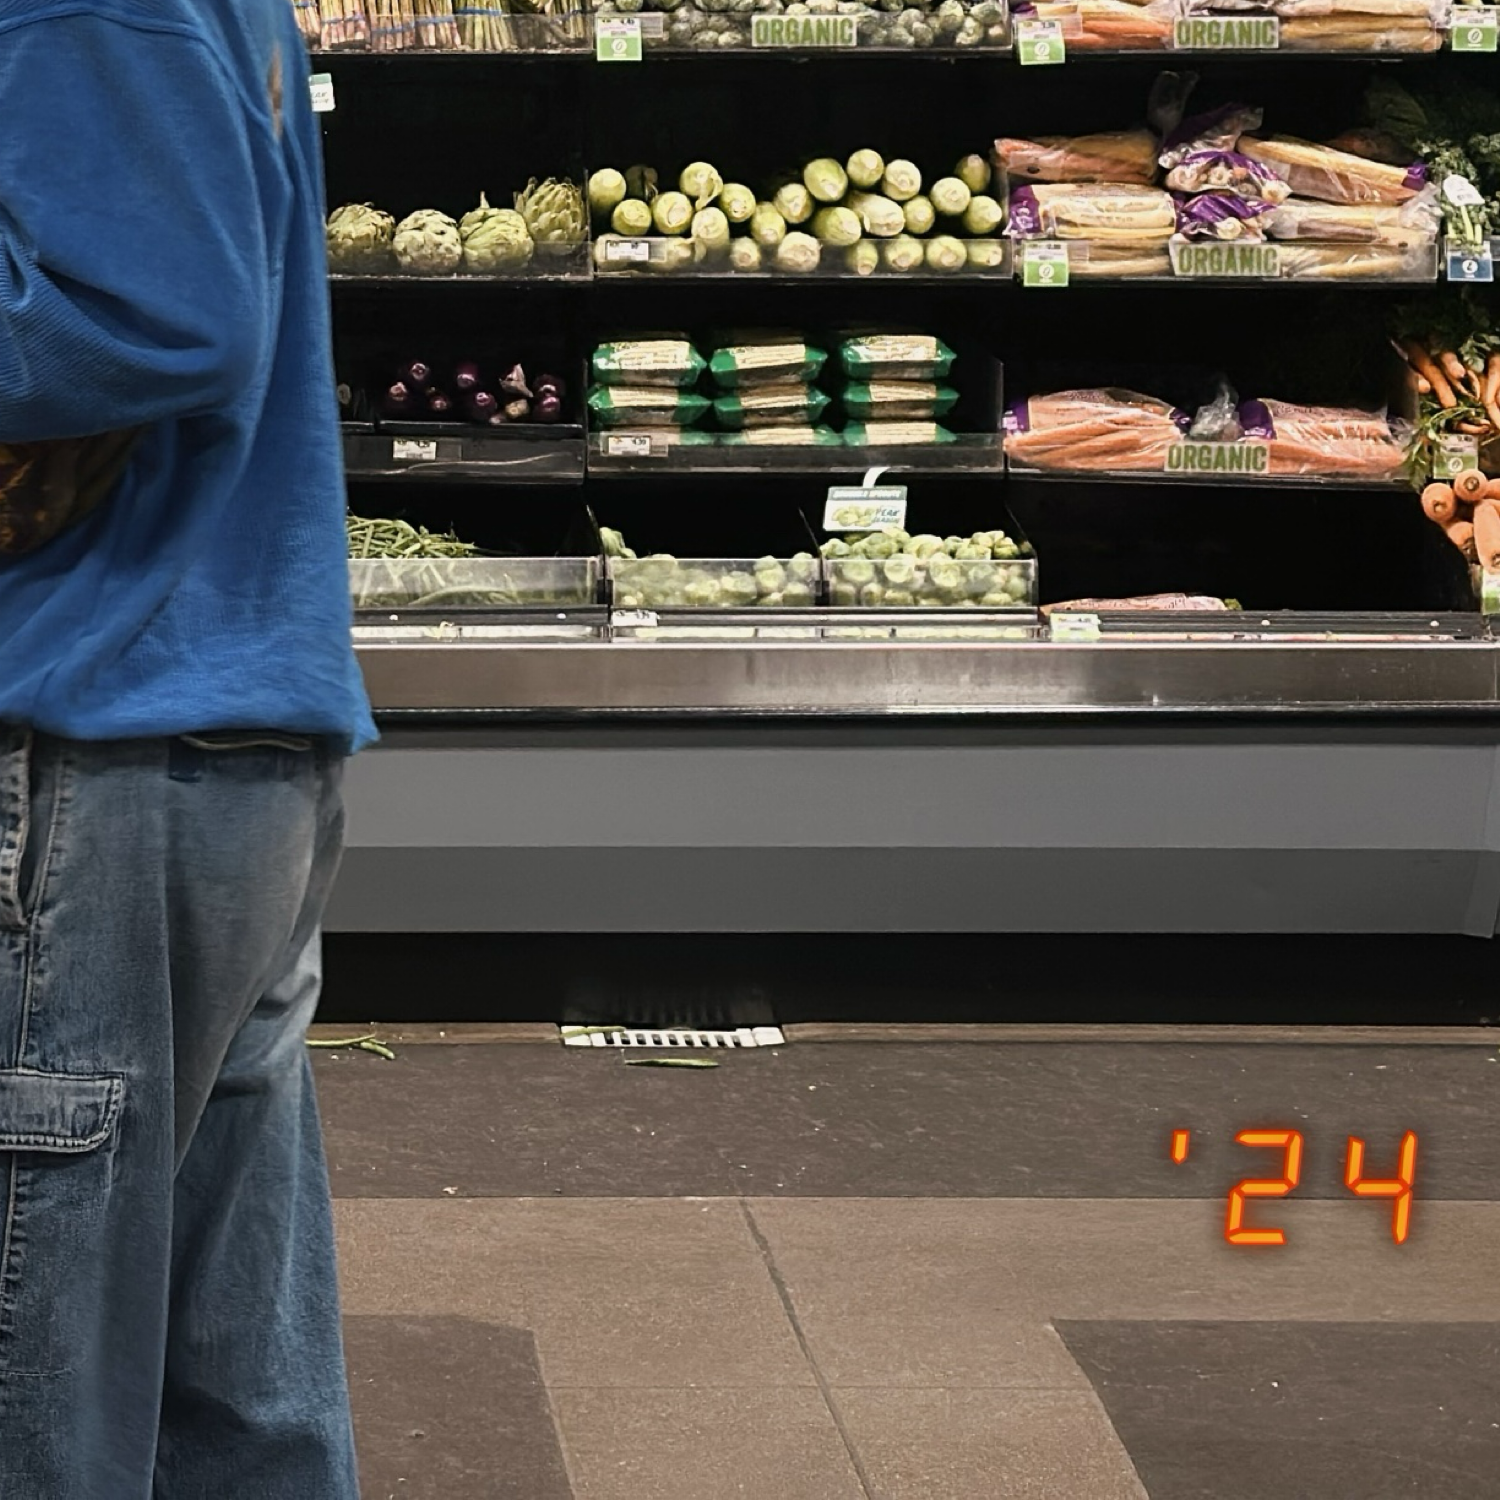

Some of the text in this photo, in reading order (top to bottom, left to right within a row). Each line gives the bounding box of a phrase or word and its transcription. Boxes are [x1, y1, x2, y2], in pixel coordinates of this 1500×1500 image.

[755, 18, 854, 45] ORGANIC
[1177, 19, 1275, 46] ORGANIC
[1179, 246, 1277, 274] ORGANIC
[1168, 445, 1266, 471] ORGANIC
